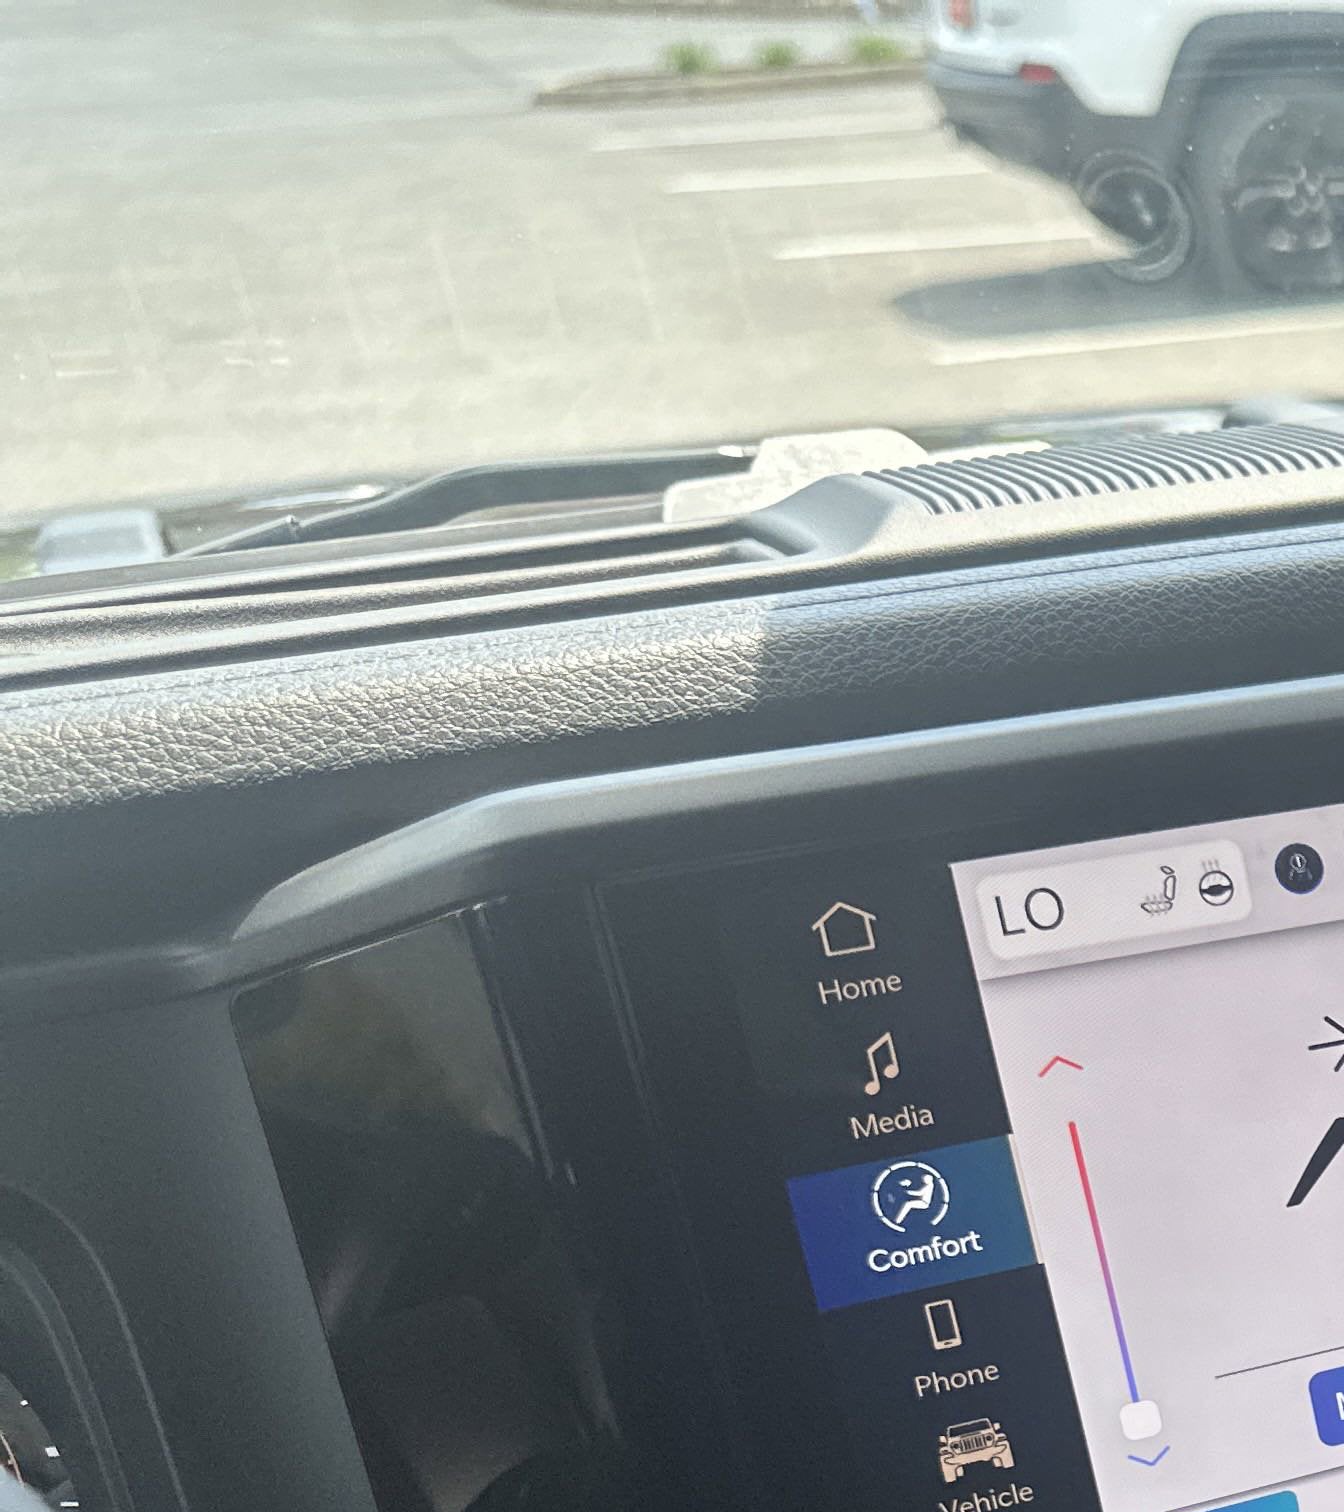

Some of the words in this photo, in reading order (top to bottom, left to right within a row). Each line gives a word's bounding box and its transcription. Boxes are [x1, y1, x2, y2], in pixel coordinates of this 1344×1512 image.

[994, 887, 1065, 936] LO
[817, 973, 903, 1005] Home
[851, 1104, 935, 1139] Media
[868, 1230, 983, 1272] Comfort
[914, 1362, 1000, 1398] Phone
